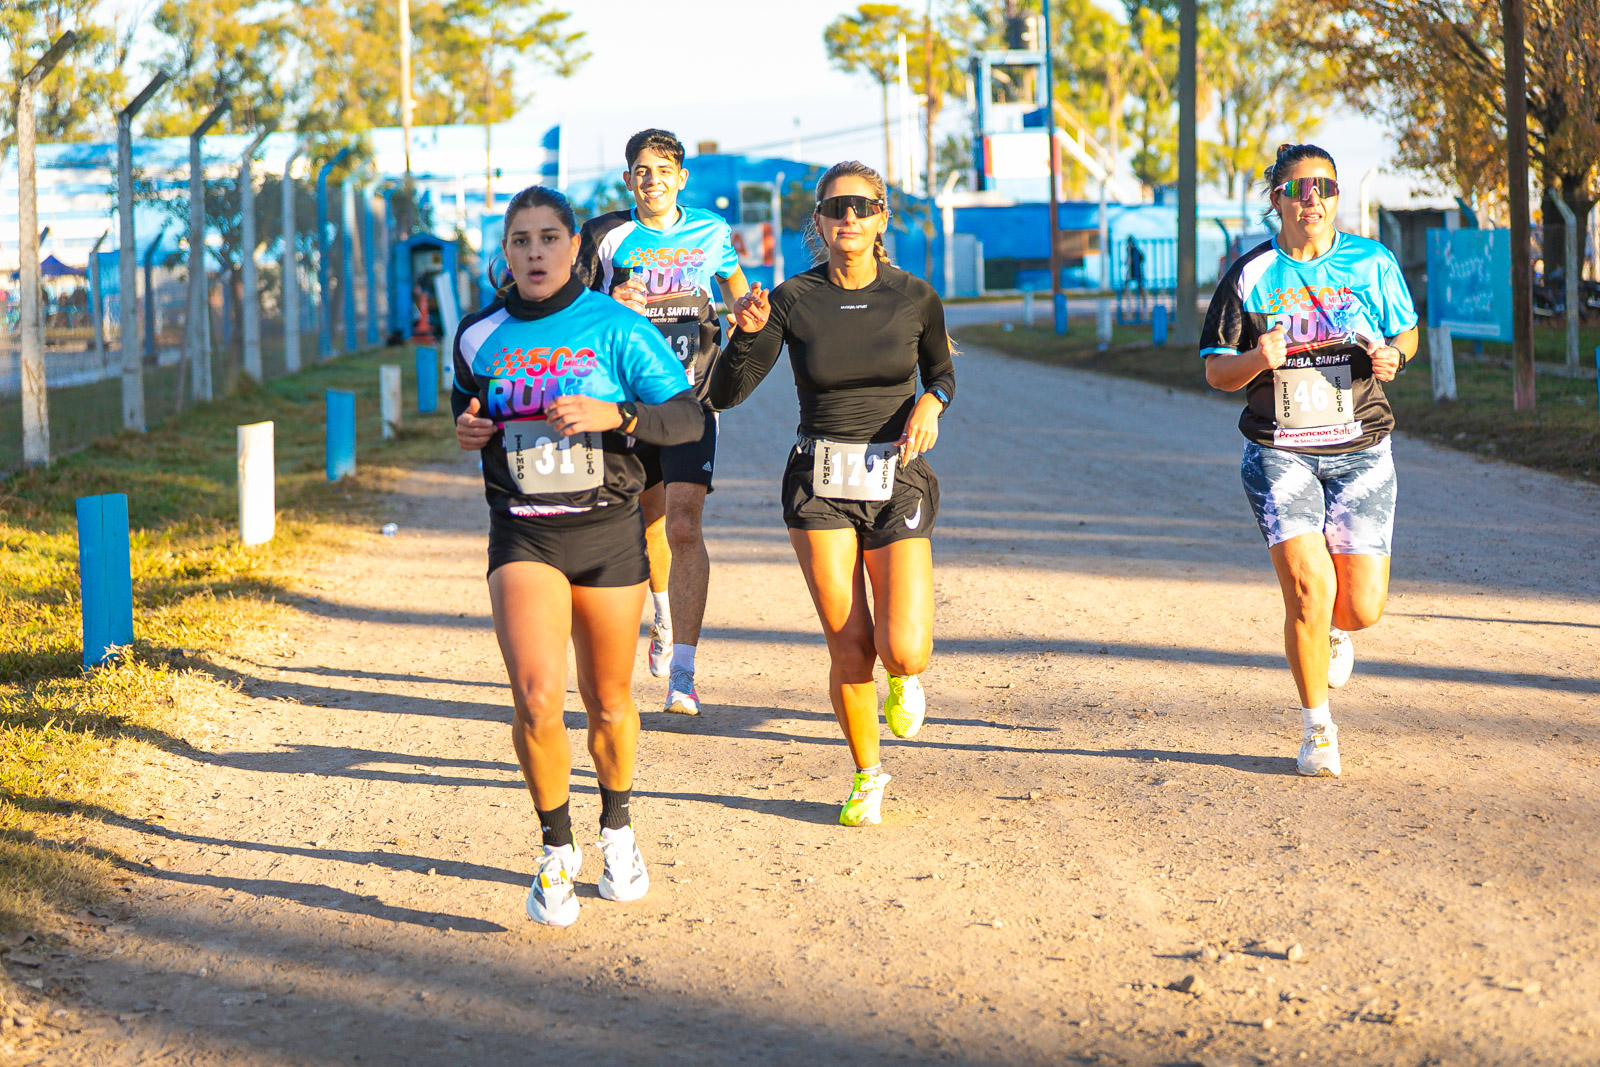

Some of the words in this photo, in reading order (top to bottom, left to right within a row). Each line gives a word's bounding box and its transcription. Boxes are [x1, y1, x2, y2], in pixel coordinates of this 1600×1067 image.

[657, 248, 704, 267] 500
[667, 307, 690, 316] SANTA
[690, 307, 699, 316] FE
[1299, 286, 1352, 311] 500
[524, 347, 597, 377] 500
[562, 359, 598, 368] MILLAS
[1315, 355, 1341, 366] SANTA
[1281, 381, 1290, 418] TIEMPO
[1294, 380, 1329, 413] 46
[1334, 376, 1344, 413] EXACTO
[515, 434, 525, 479] TIEMPO
[535, 436, 575, 475] 31
[823, 447, 831, 485] TIEMPO
[881, 450, 890, 490] EXACTO
